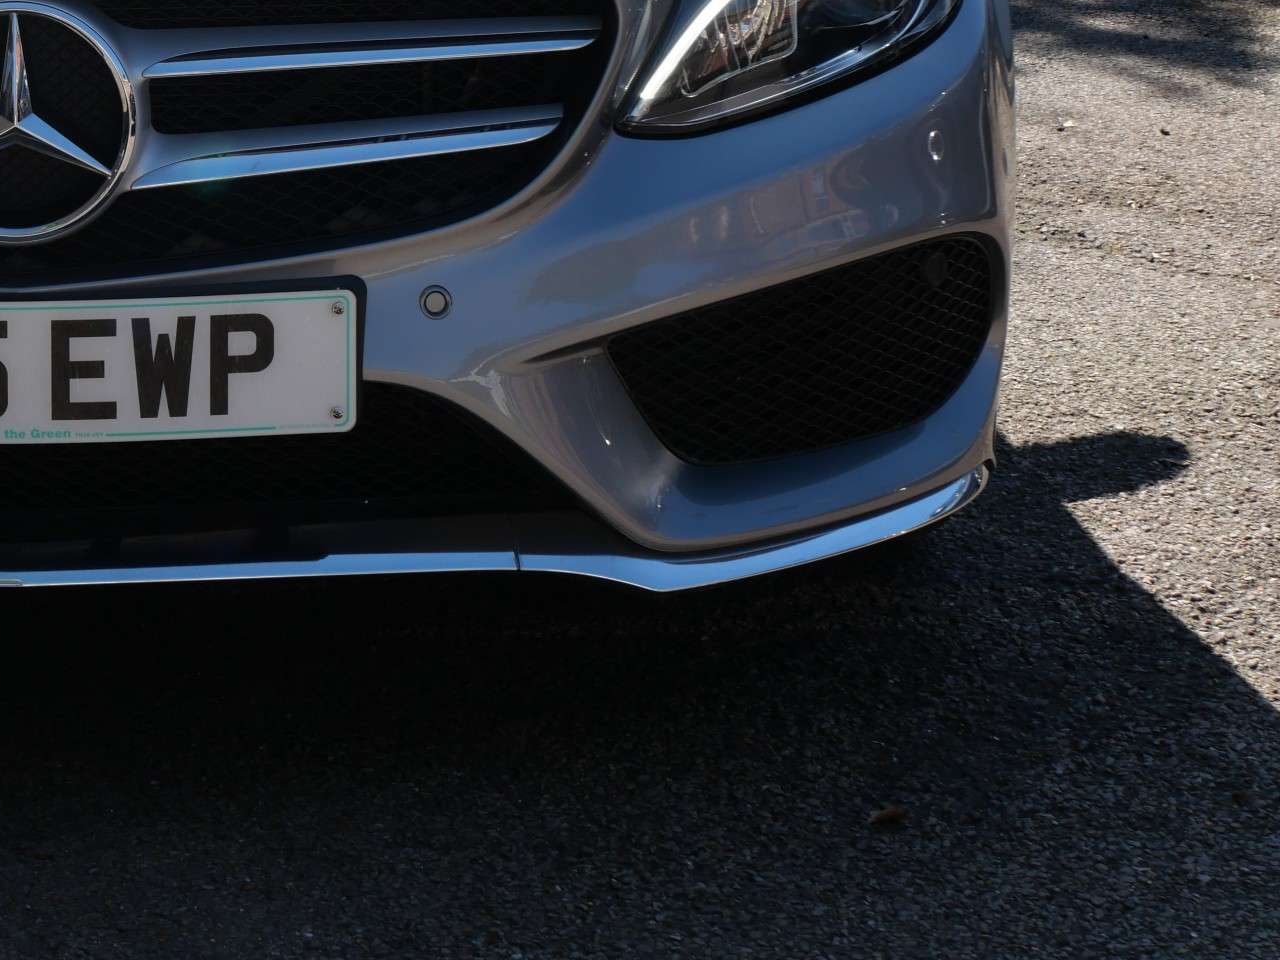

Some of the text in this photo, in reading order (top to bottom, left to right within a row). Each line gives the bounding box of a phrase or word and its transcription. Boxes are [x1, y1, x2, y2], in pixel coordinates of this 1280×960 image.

[51, 313, 275, 421] EWP
[4, 428, 26, 439] the
[31, 427, 72, 439] Green
